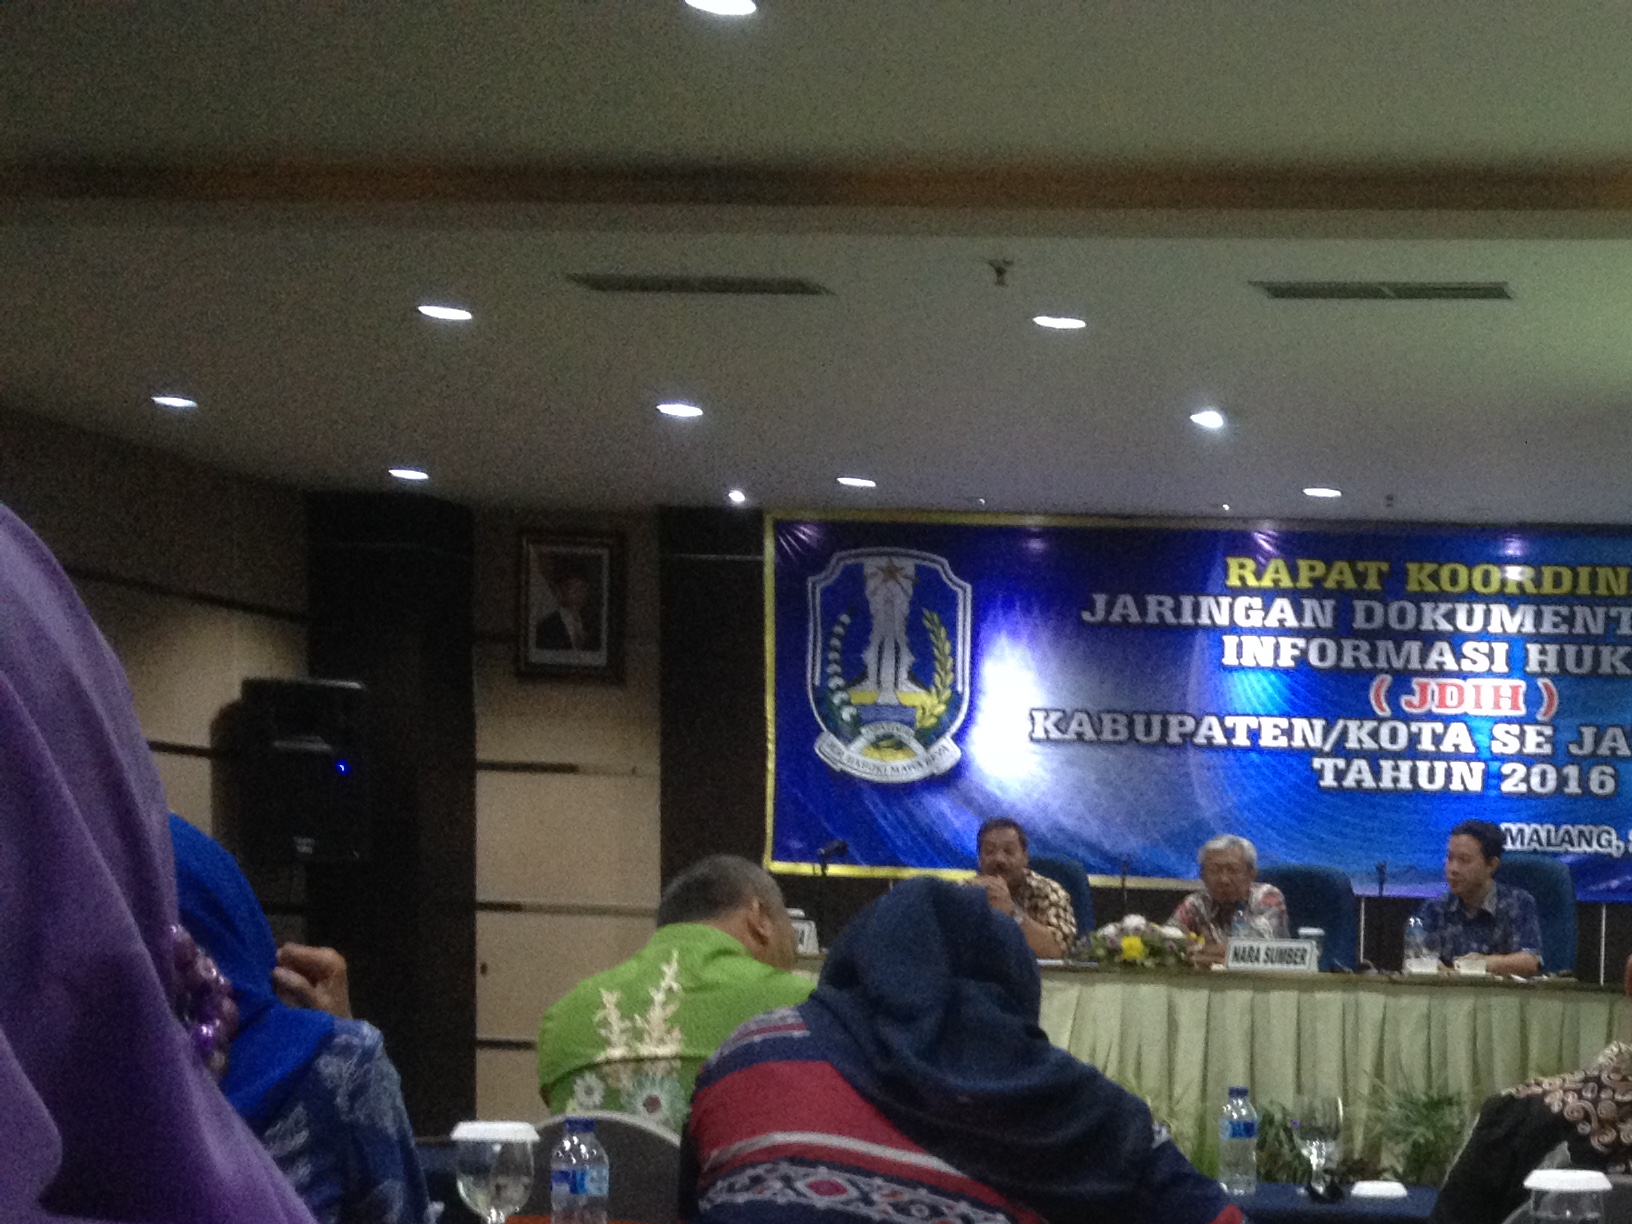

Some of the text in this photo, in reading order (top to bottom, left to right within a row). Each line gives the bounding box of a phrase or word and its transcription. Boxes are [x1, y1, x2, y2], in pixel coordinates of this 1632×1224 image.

[1225, 556, 1391, 591] RAPAT
[1080, 593, 1336, 629] JARINGAN
[1221, 634, 1509, 673] INFORMASI
[1401, 678, 1527, 717] JDIH
[1030, 708, 1476, 753] KABUPATEN/KOTA
[1491, 723, 1554, 756] SE
[1312, 757, 1618, 796] TAHUN 2016
[1501, 823, 1625, 858] MALANG,
